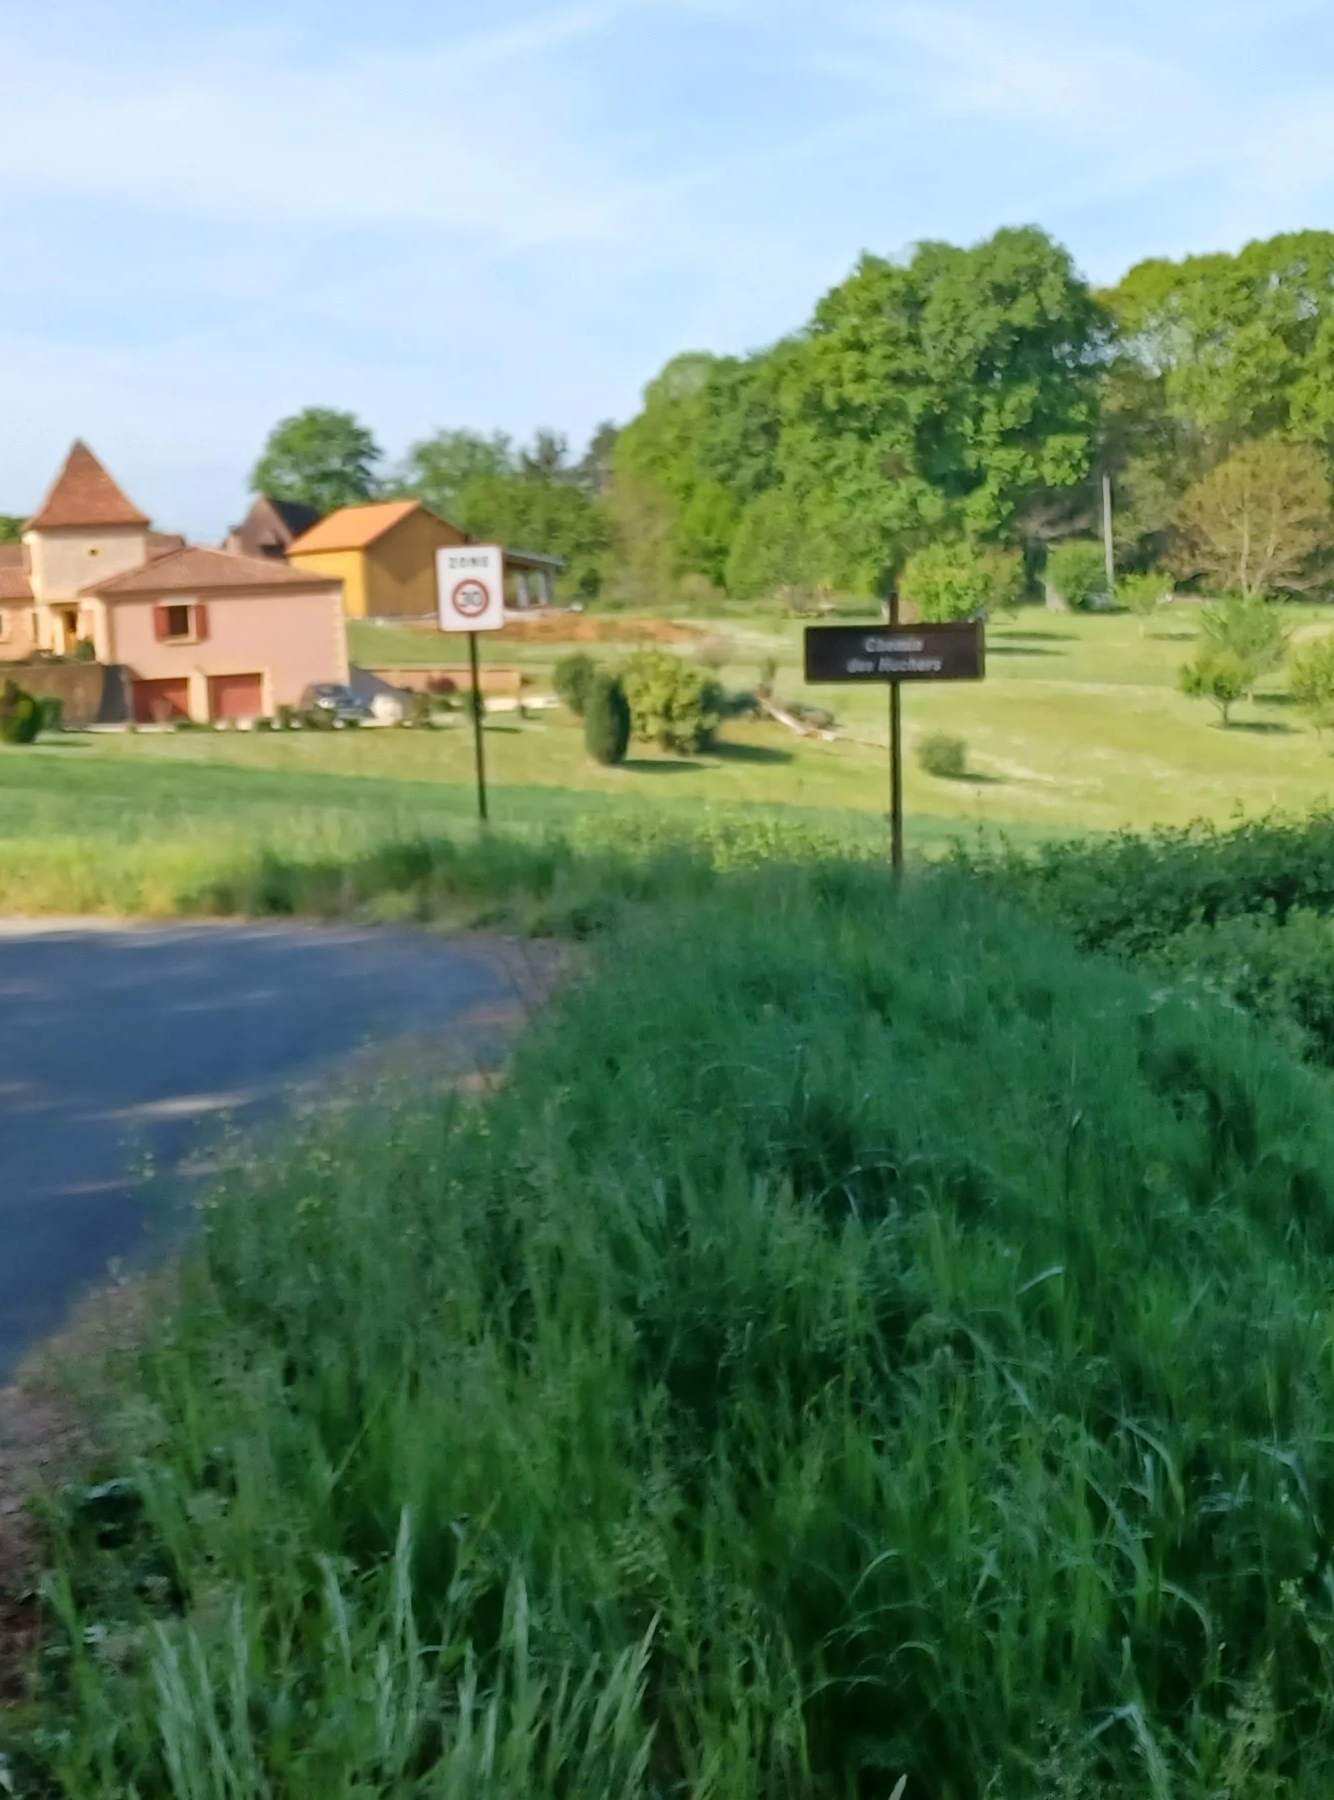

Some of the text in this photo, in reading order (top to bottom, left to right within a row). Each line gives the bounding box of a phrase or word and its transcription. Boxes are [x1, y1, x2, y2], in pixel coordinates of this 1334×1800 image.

[448, 556, 489, 569] ZONE
[459, 591, 483, 608] 30
[865, 637, 924, 653] Chemin
[847, 658, 875, 674] des
